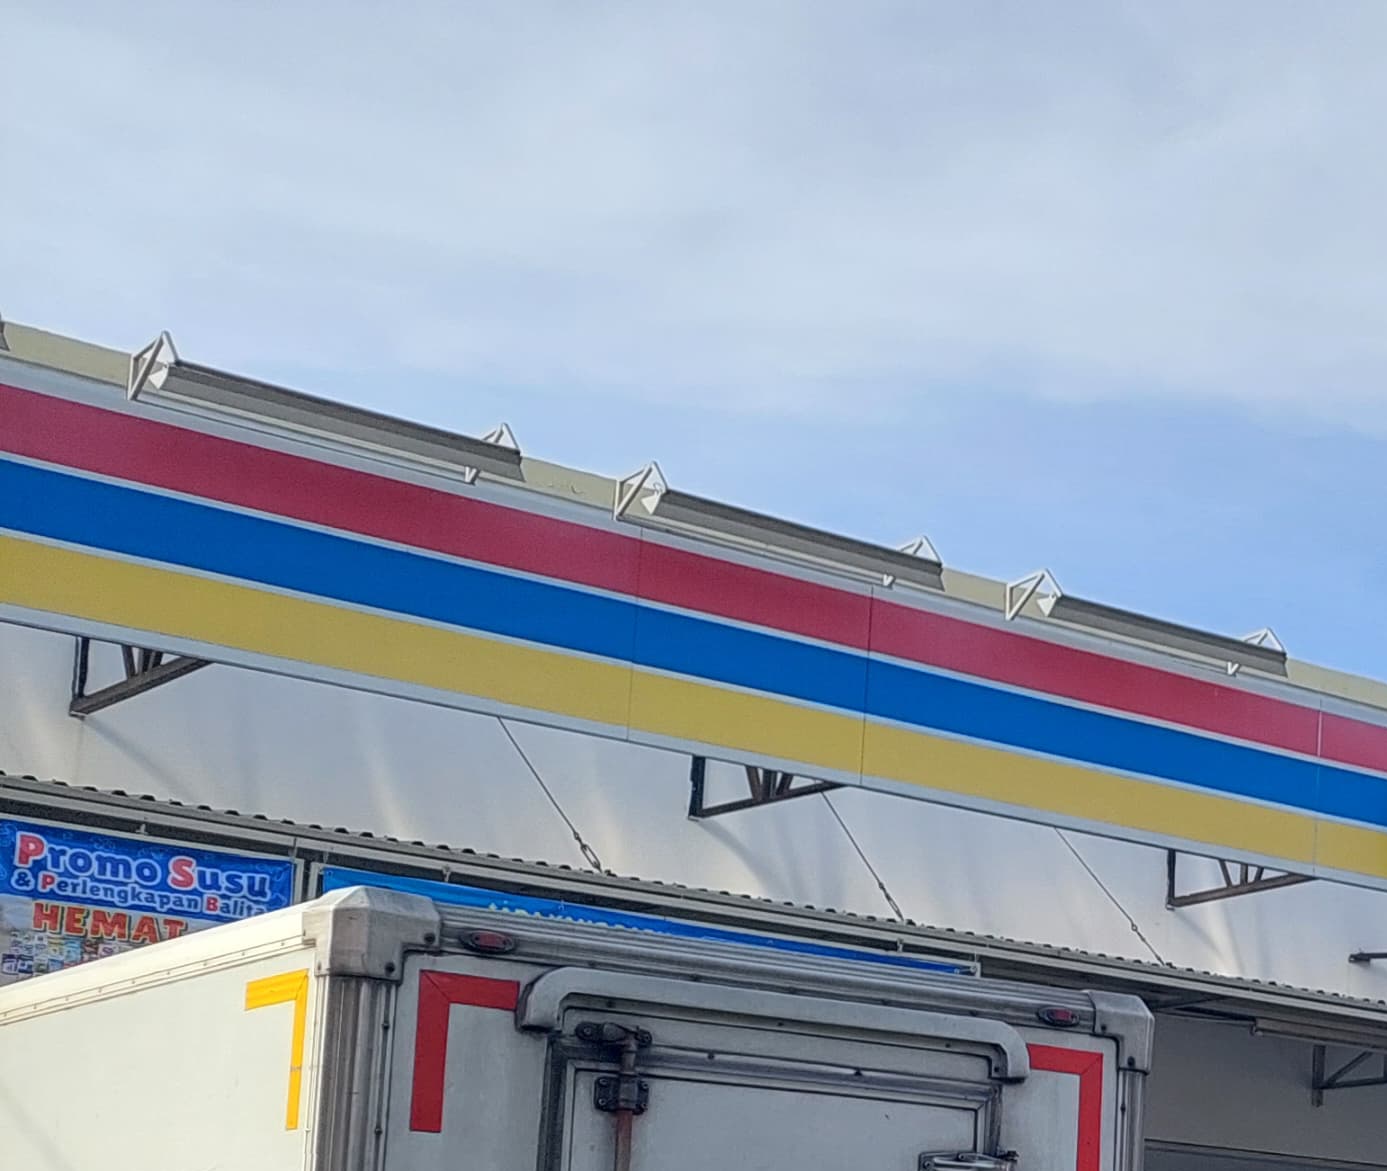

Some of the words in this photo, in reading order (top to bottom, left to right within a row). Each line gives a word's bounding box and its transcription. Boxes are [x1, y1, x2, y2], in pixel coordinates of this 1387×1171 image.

[17, 832, 160, 885] Promo
[169, 856, 271, 899] Susu
[12, 869, 34, 890] &
[40, 872, 199, 912] Perlengkapan
[205, 895, 269, 918] Balita
[33, 902, 188, 944] HEMAT
